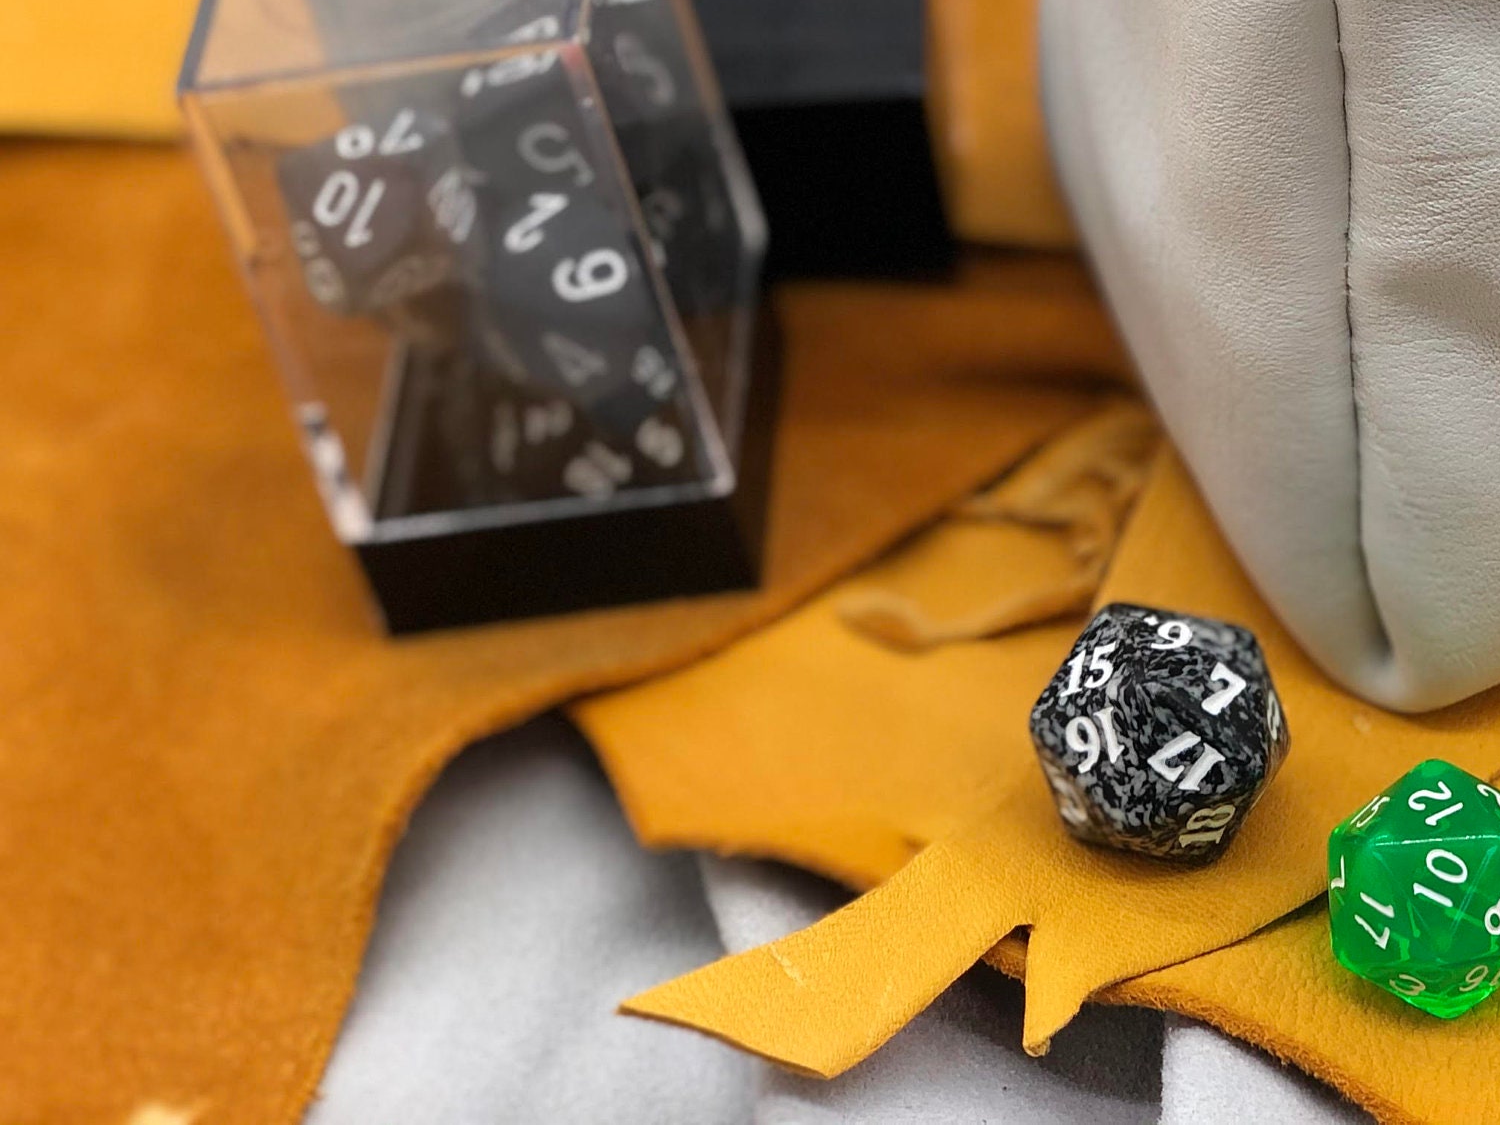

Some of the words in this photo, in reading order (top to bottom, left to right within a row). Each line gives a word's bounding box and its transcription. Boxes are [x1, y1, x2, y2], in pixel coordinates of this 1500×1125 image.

[312, 170, 386, 249] 10
[503, 193, 568, 253] 2
[1060, 641, 1117, 698] 15
[1201, 662, 1247, 715] 7
[1065, 707, 1125, 775] 16
[1147, 731, 1226, 791] 17
[1179, 804, 1237, 848] 18
[1408, 781, 1464, 826] 12
[1413, 849, 1468, 908] 10
[1354, 892, 1395, 950] 17
